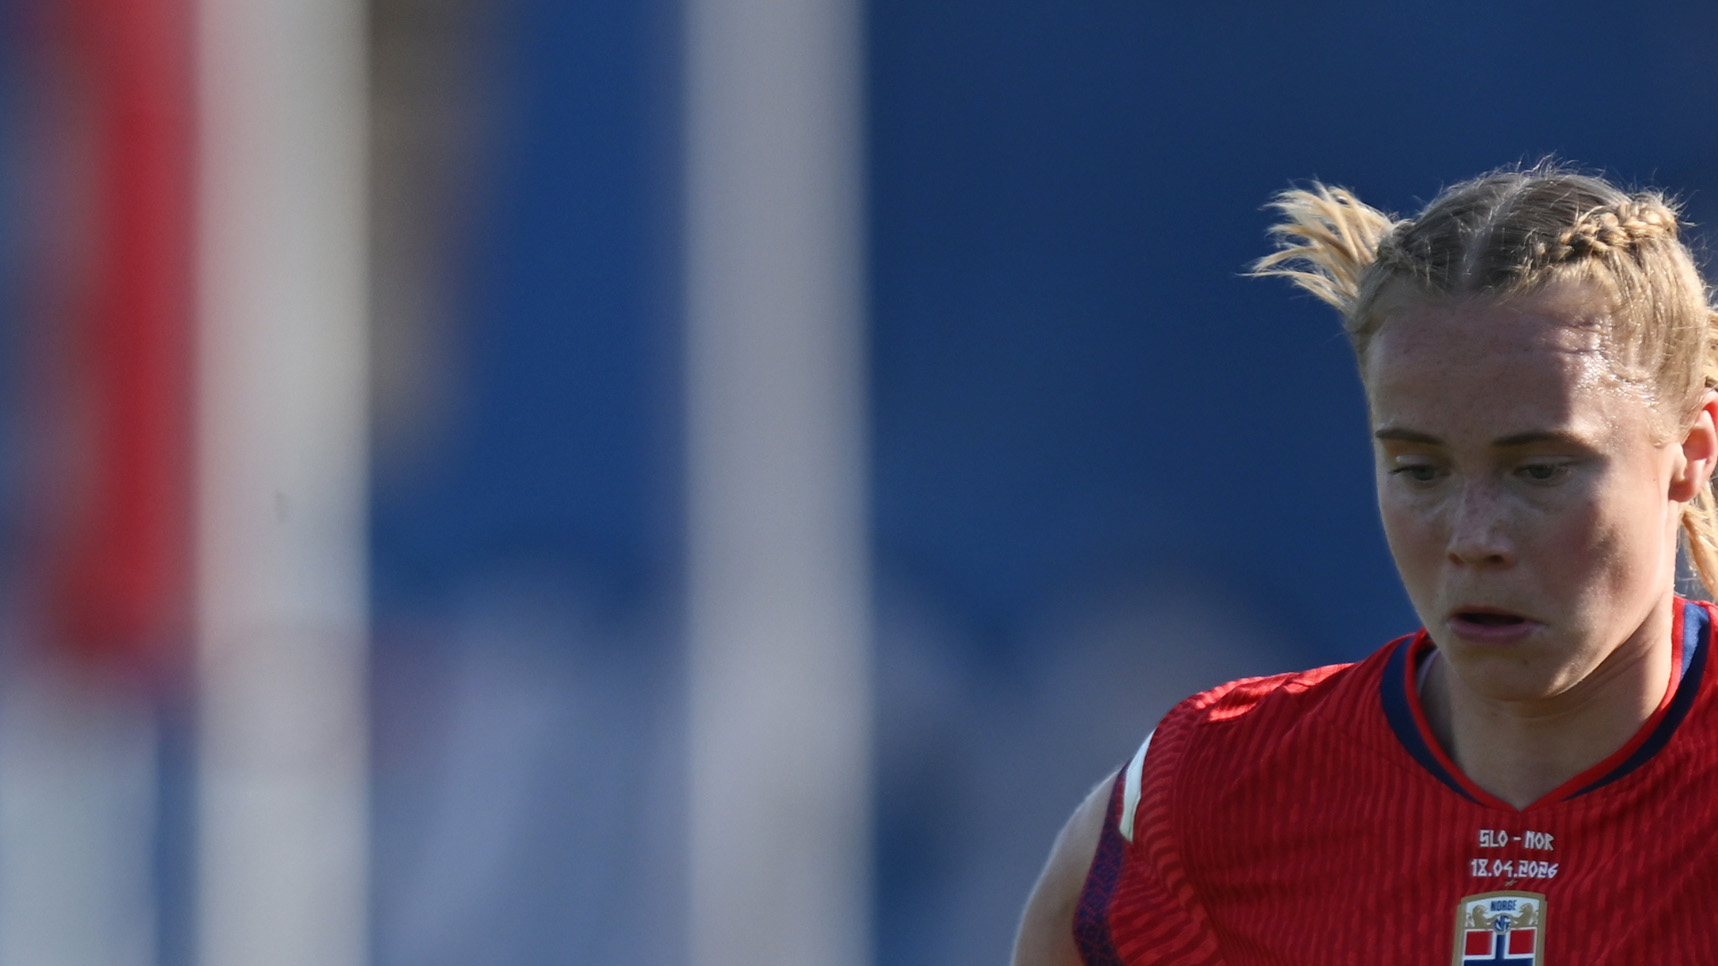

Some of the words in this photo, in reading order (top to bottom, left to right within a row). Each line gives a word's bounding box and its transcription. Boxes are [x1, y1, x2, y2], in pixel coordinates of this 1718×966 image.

[1479, 829, 1508, 847] SLO
[1524, 830, 1554, 850] NOR
[1471, 859, 1559, 878] 18.04.2026
[1490, 900, 1517, 911] NORGE
